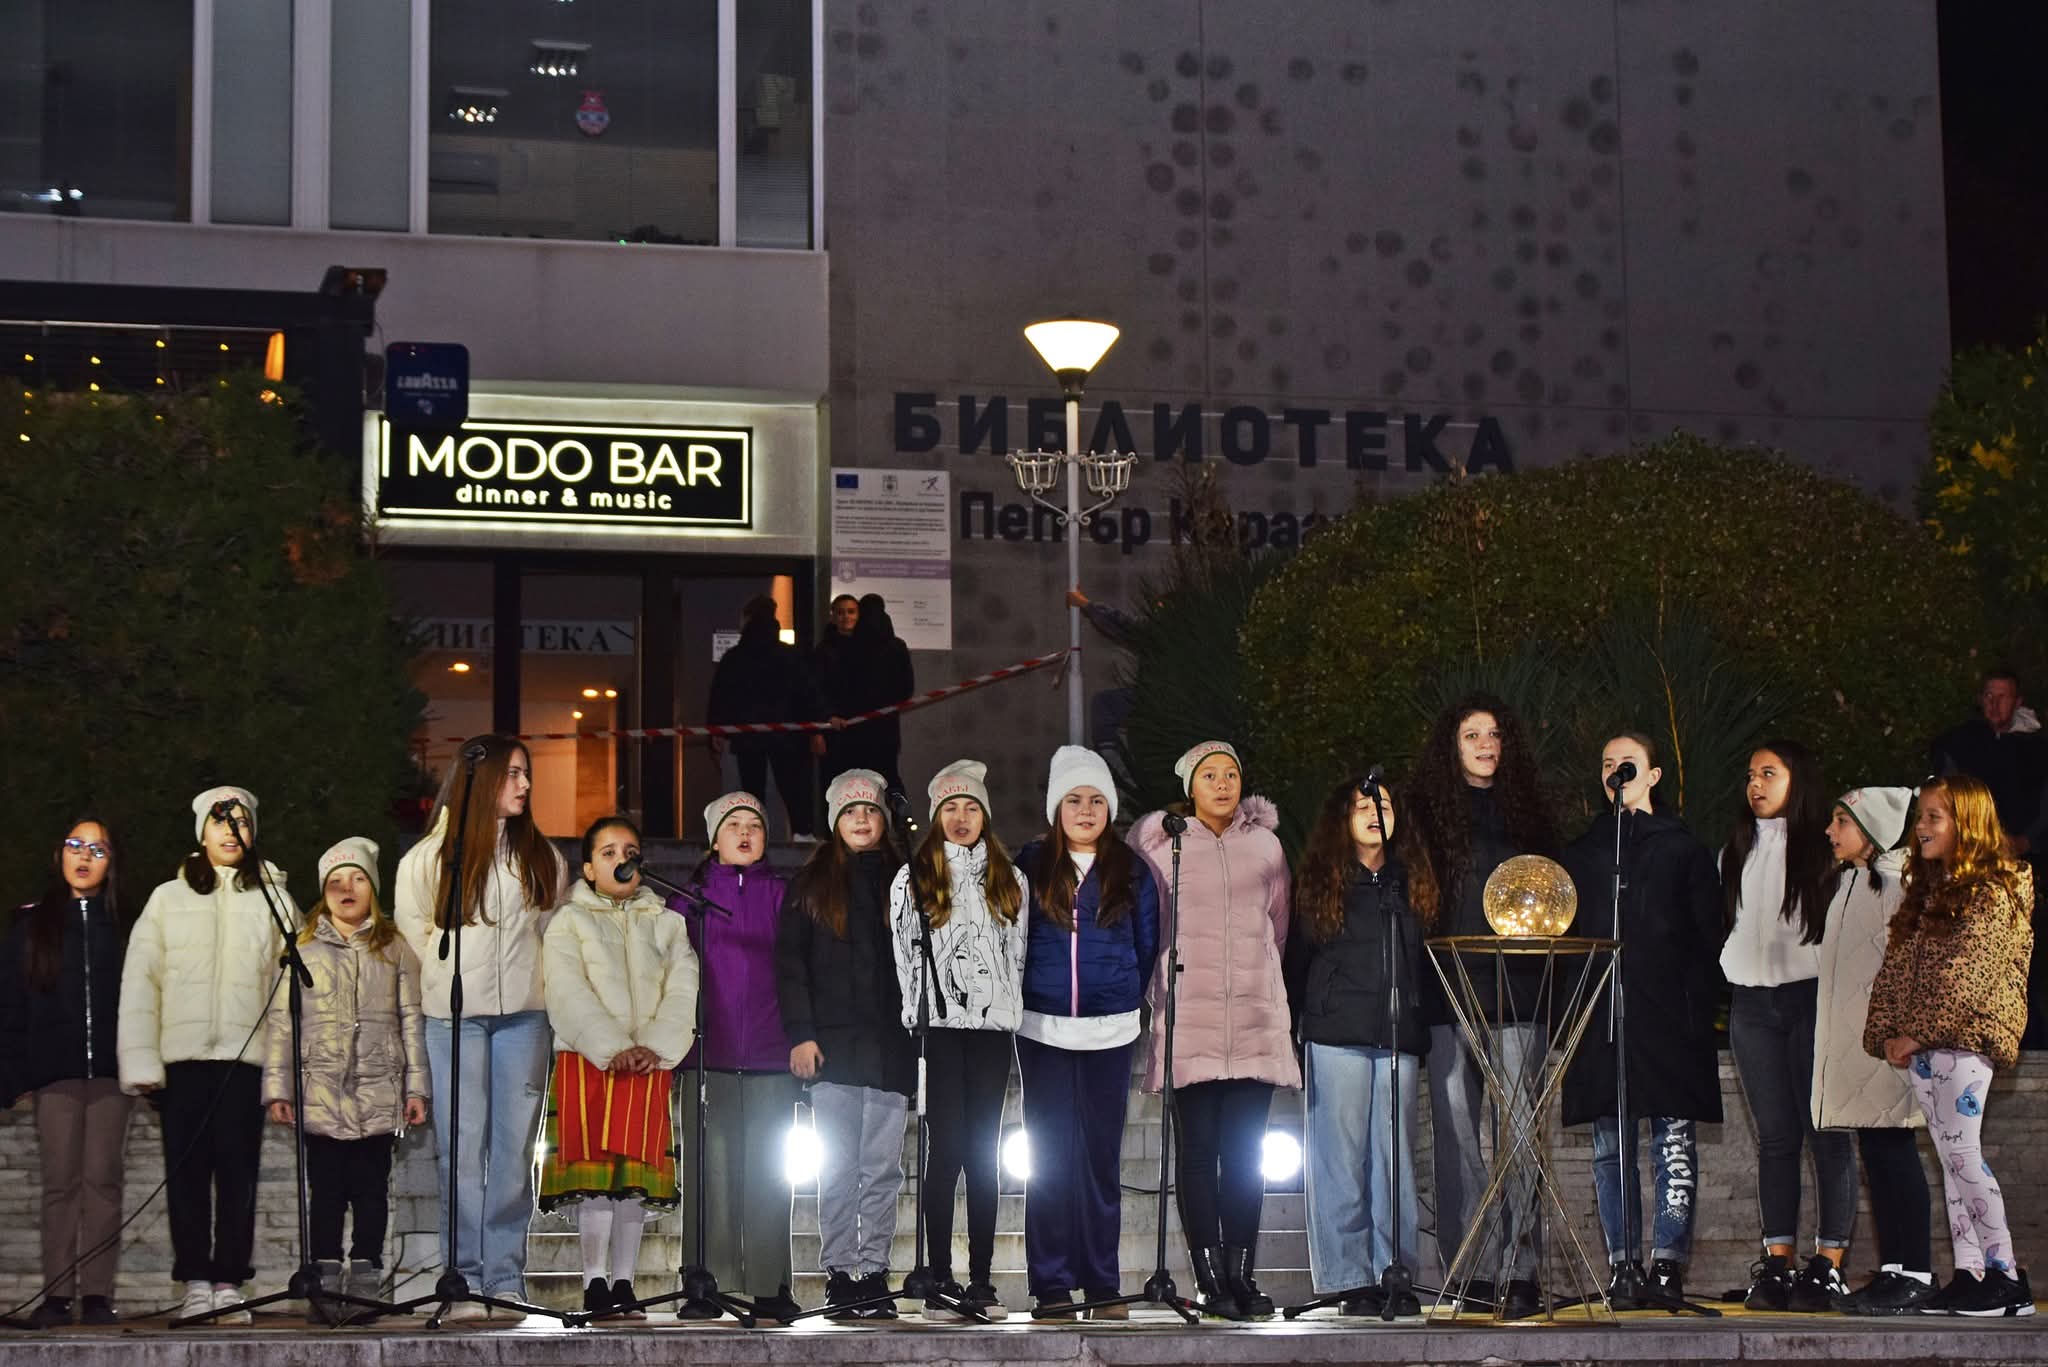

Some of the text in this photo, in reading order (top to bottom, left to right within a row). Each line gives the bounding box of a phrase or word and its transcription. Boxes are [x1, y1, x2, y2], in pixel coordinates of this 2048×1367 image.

[894, 391, 1514, 474] БИБЛИОТЕКА
[409, 433, 722, 488] MODO BAR
[456, 483, 672, 510] dinner & music
